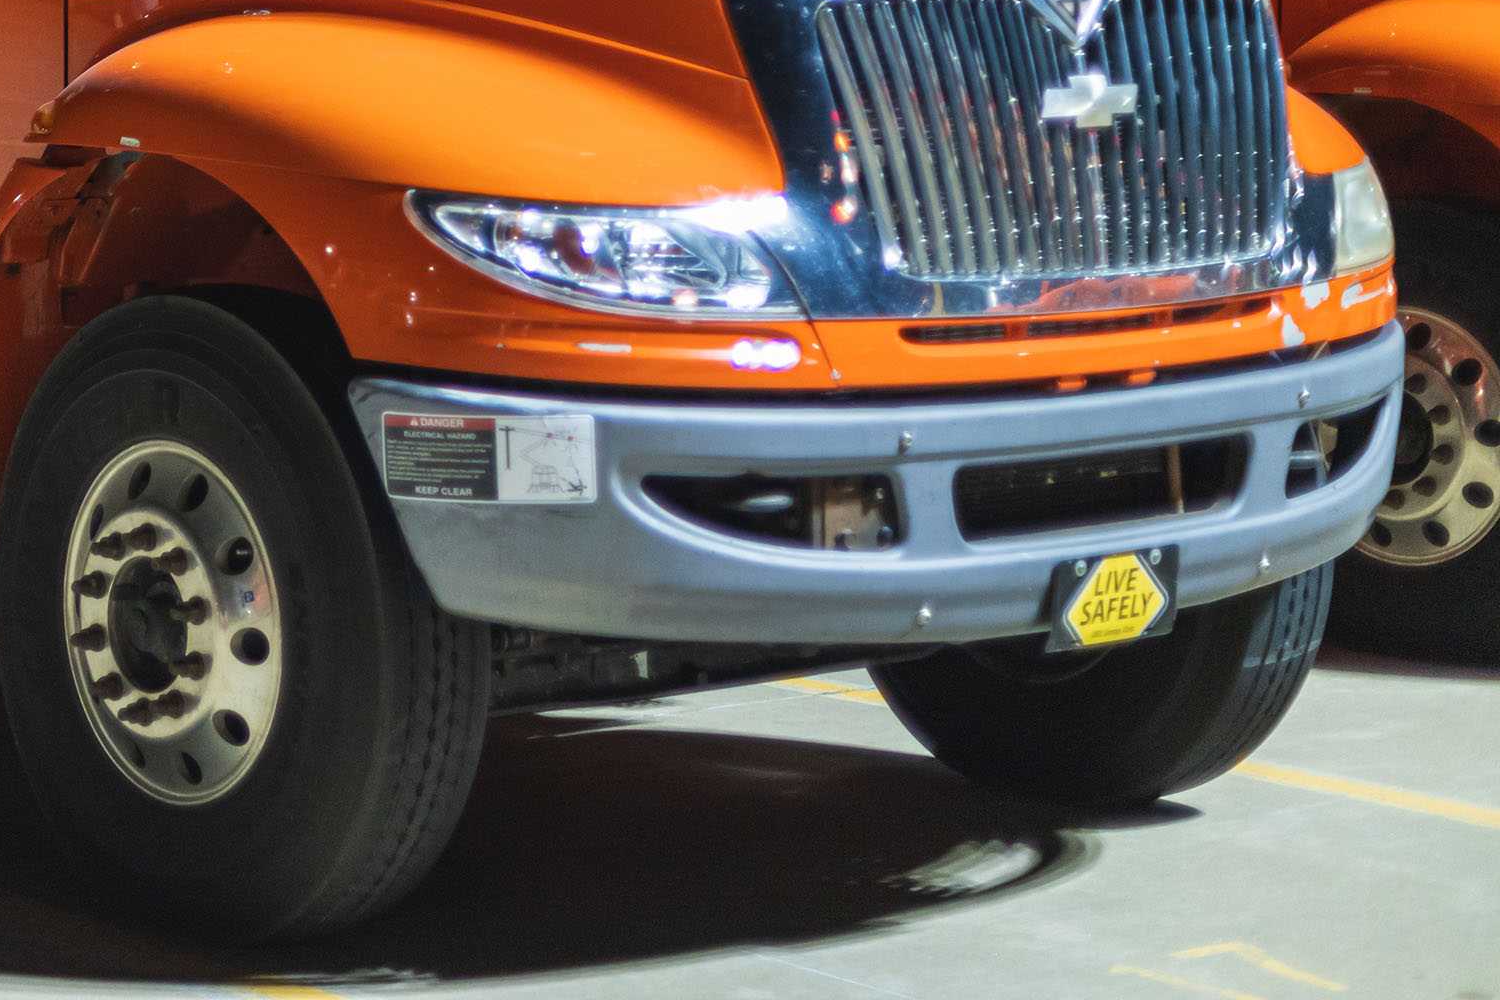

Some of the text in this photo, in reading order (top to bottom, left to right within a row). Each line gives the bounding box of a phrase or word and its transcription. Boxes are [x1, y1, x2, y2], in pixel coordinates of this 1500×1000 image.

[420, 417, 465, 428] DANGER
[403, 430, 477, 441] ELECTRICAL HAZARD
[414, 485, 473, 497] KEEP CLEAR
[1094, 567, 1140, 597] LIVE
[1079, 591, 1154, 626] SAFELY
